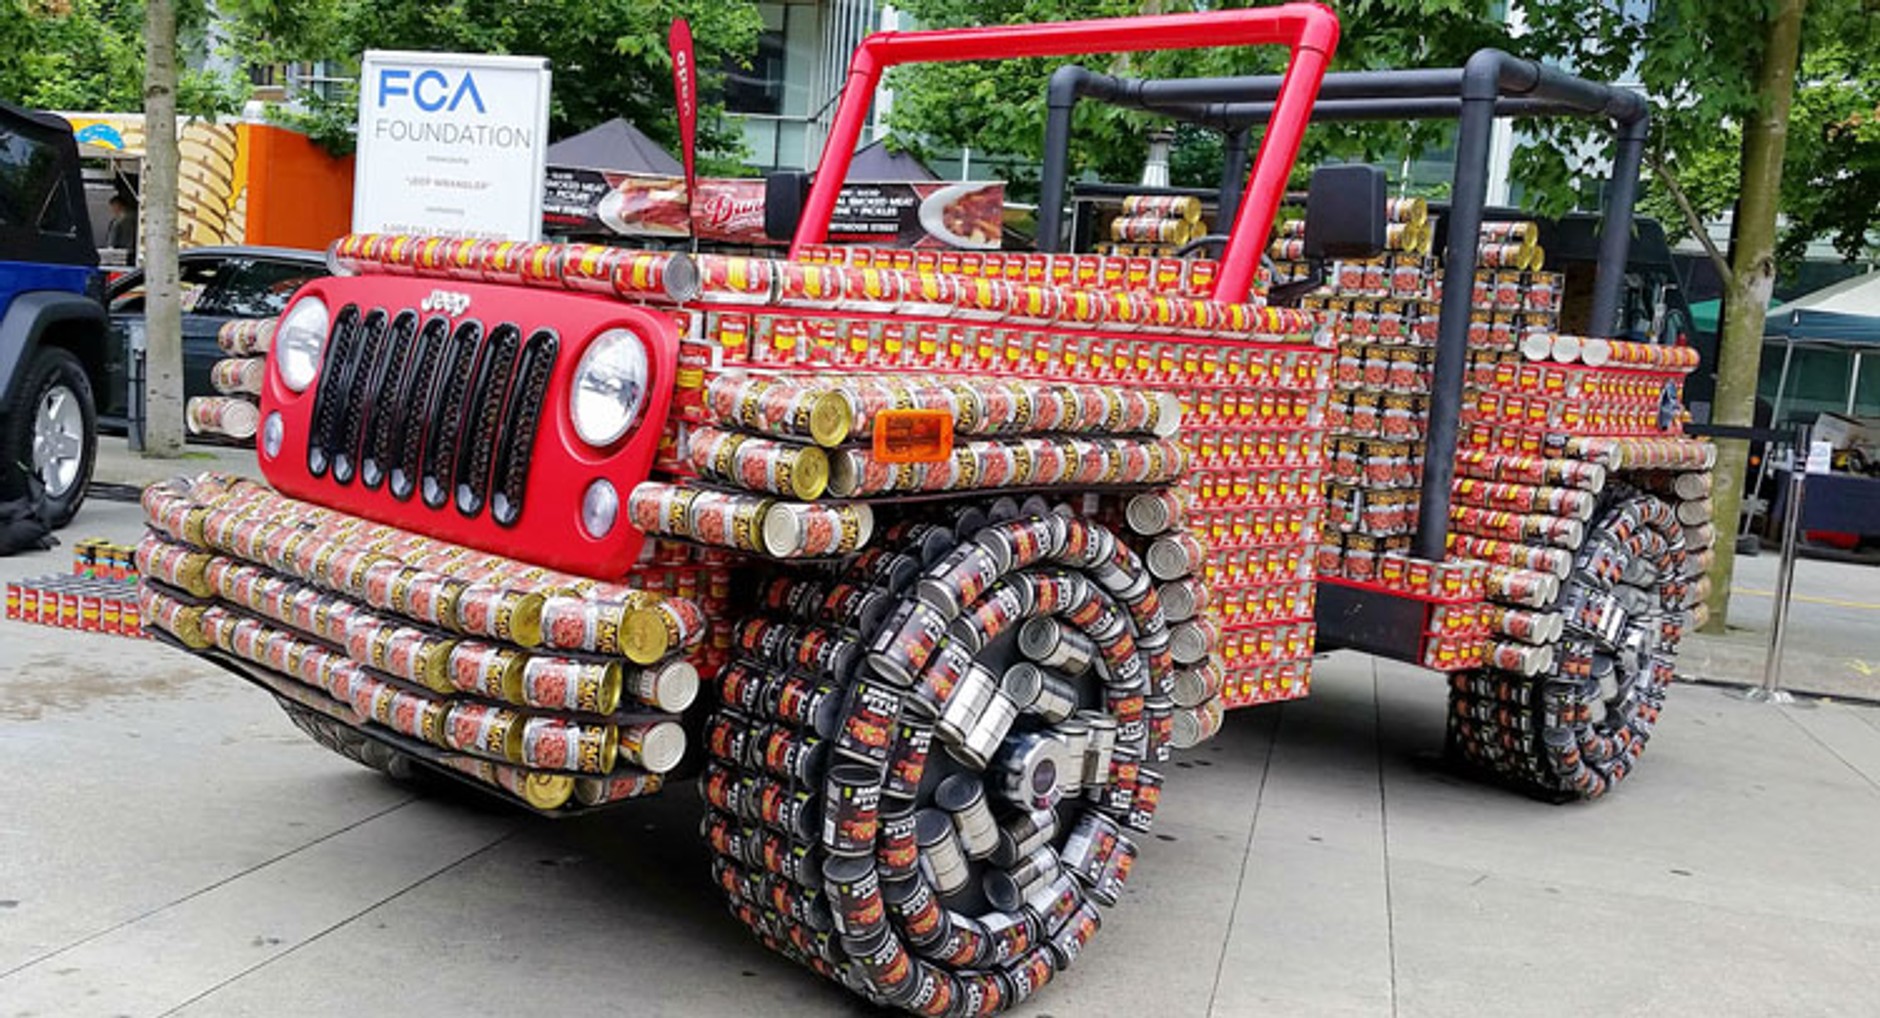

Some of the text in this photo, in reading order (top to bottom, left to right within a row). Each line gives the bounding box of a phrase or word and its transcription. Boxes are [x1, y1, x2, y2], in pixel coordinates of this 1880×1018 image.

[378, 69, 486, 114] FCA
[376, 118, 531, 149] FOUNDATION
[421, 289, 471, 318] Jeep
